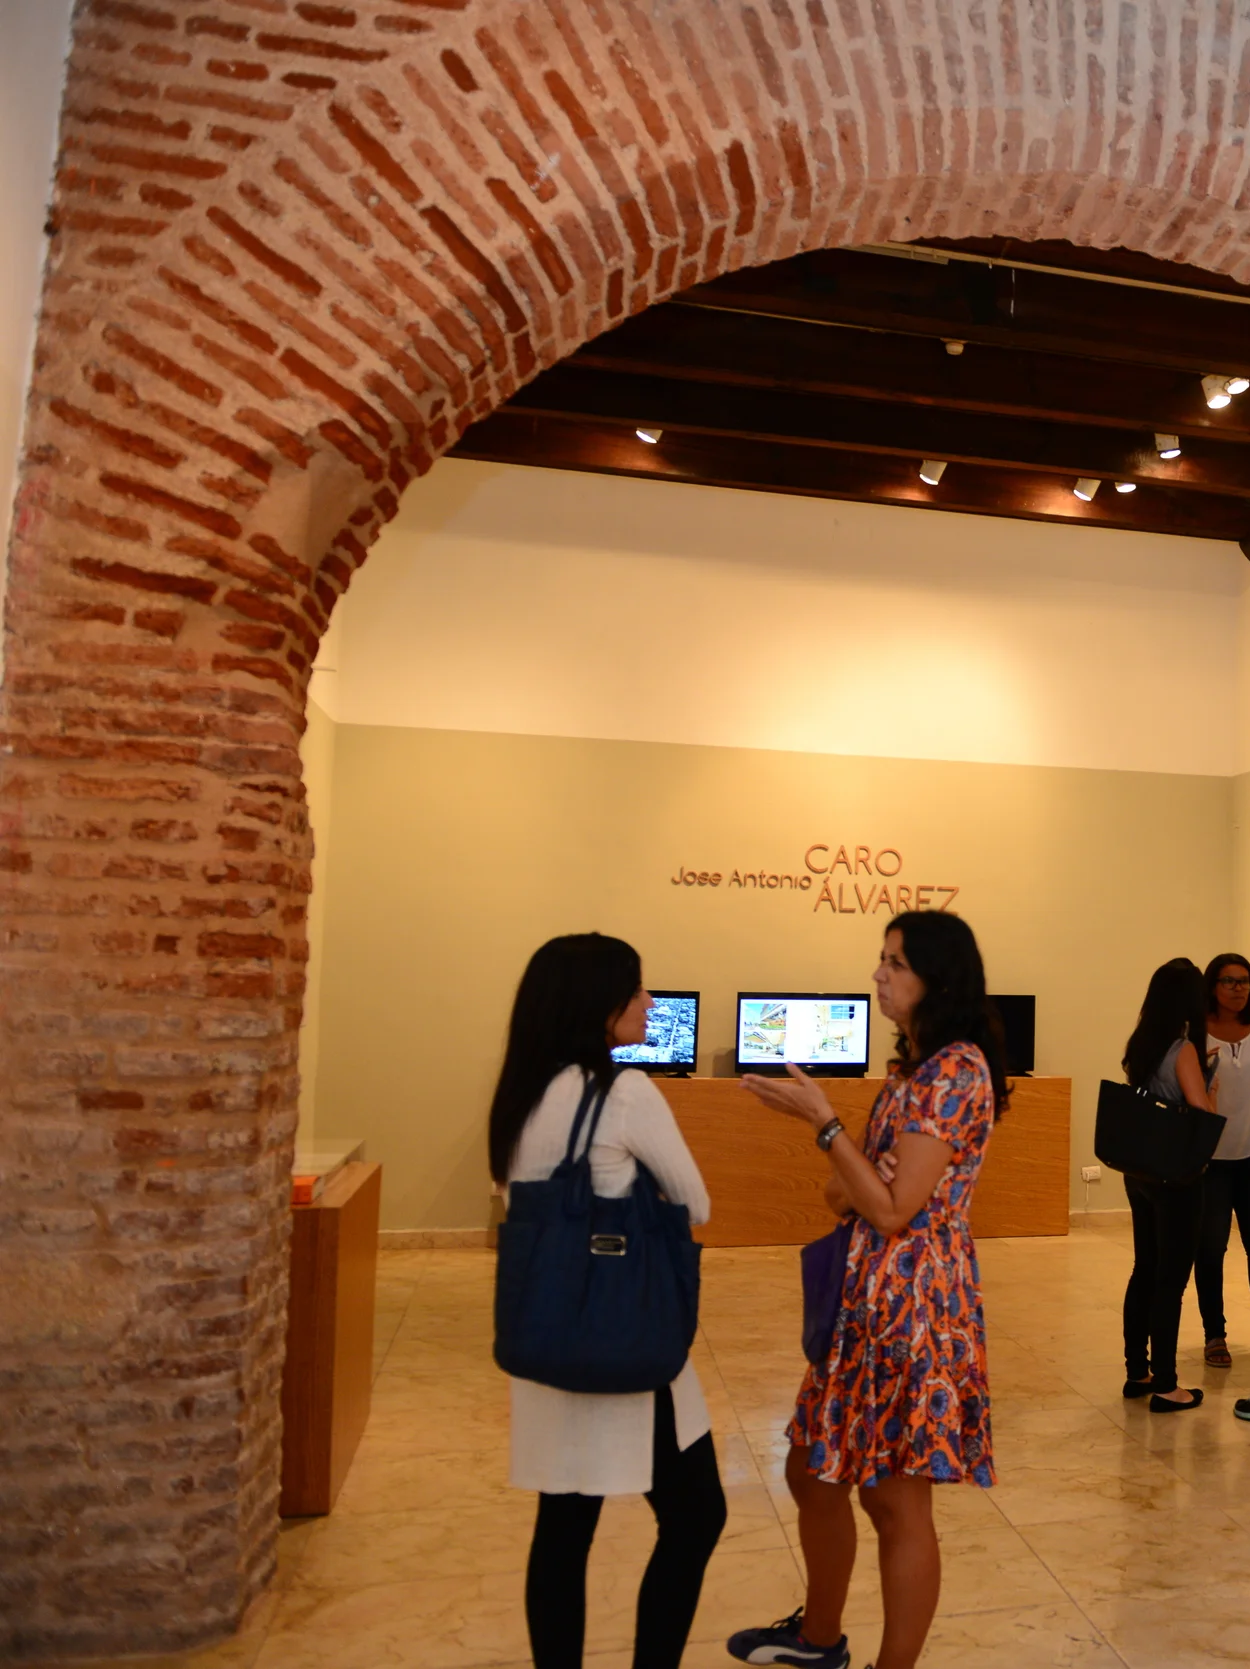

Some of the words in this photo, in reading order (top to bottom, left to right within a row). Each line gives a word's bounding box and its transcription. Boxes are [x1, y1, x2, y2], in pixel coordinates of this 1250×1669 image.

[804, 843, 903, 877] CARO
[670, 866, 722, 887] Jose
[728, 869, 812, 890] Antonio
[813, 876, 960, 916] ÁLVAREZ
